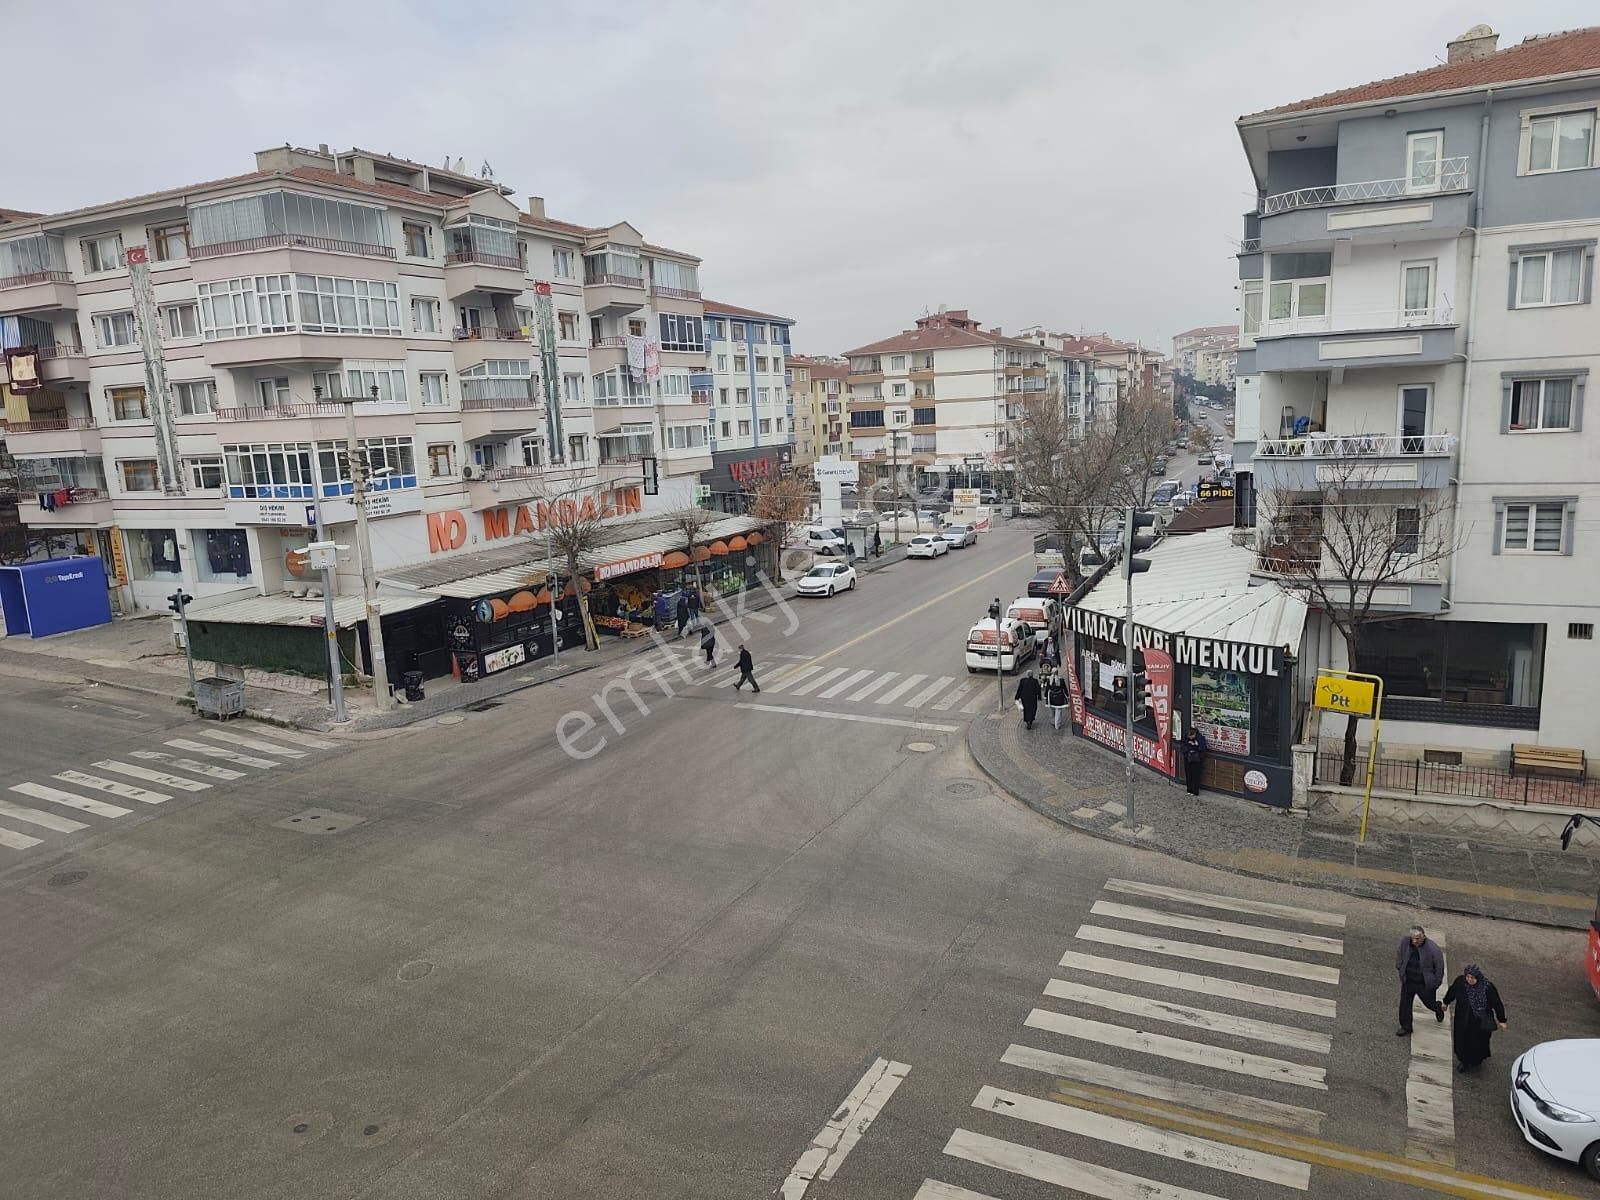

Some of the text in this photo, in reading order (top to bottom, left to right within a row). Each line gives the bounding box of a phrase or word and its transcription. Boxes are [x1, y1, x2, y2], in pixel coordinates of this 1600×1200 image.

[1062, 605, 1118, 644] YILMAZ
[1176, 636, 1280, 677] MENKUL
[1330, 693, 1351, 707] Ptt
